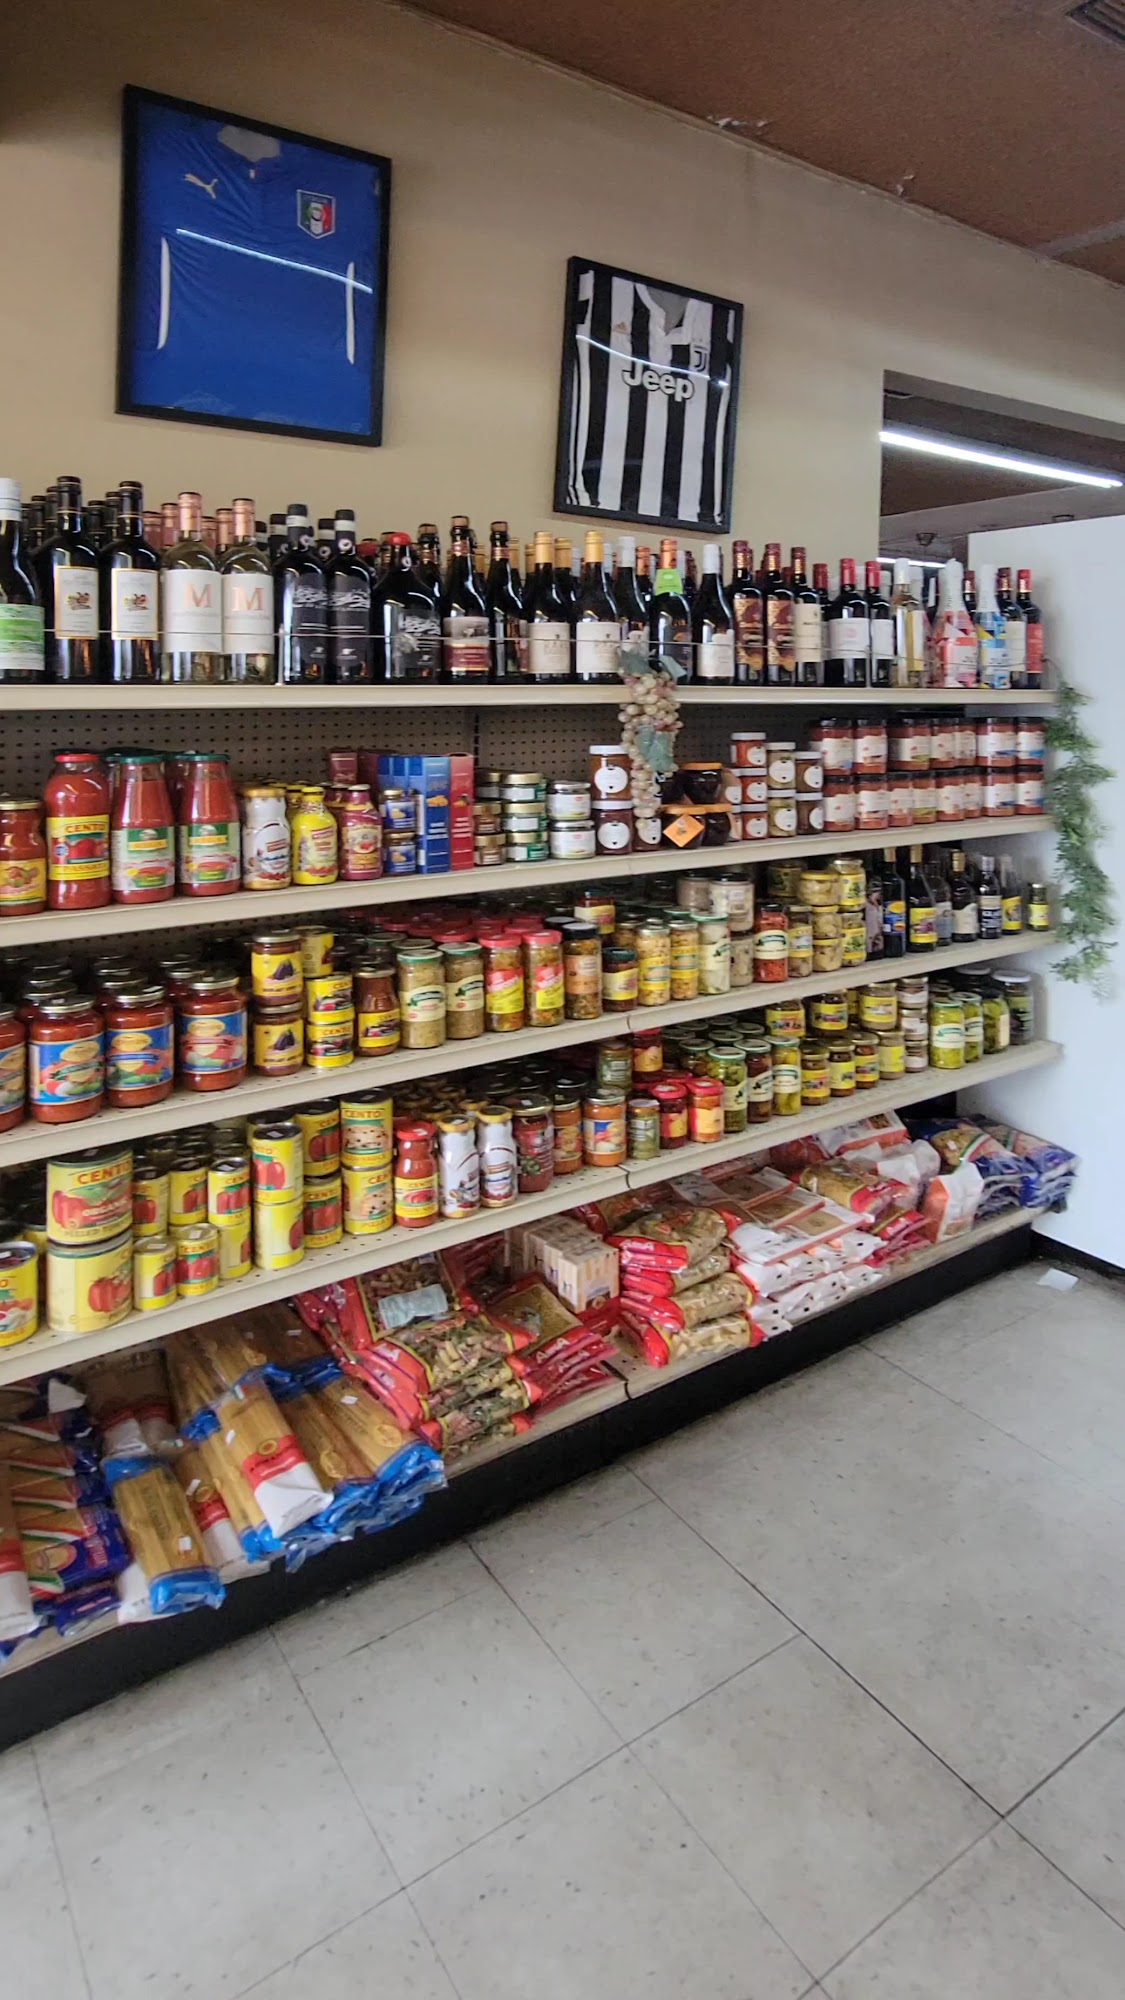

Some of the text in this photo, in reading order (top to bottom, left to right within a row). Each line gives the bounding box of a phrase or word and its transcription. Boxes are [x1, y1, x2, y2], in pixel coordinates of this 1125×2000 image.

[621, 358, 695, 402] Jeep
[186, 584, 212, 608] M
[232, 587, 264, 611] M
[66, 822, 107, 833] CENTO
